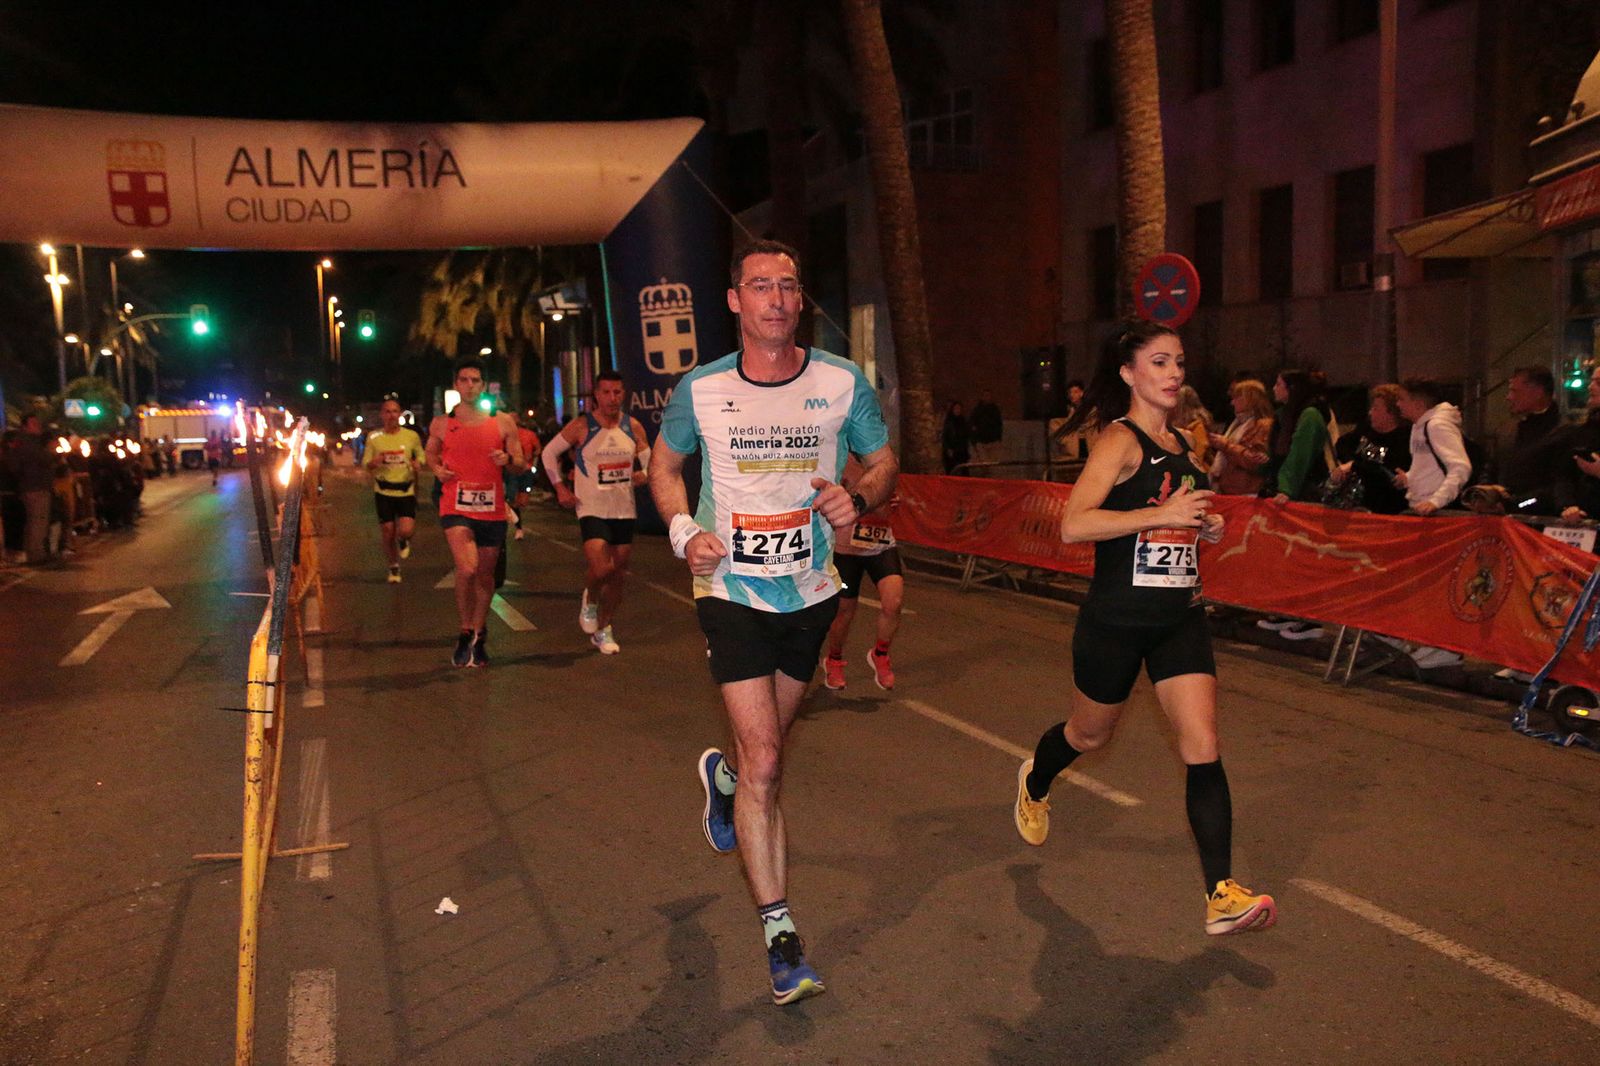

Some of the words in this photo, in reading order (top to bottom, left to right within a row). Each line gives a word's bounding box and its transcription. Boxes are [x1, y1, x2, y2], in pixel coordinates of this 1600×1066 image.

[224, 140, 467, 188] ALMERÍA
[225, 197, 351, 223] CIUDAD
[728, 425, 765, 436] Medio
[771, 424, 821, 436] Maratón
[730, 436, 782, 449] Almería
[785, 435, 819, 449] 2022
[731, 452, 761, 461] RAMÓN
[784, 451, 819, 460] ANDÚJAR
[471, 491, 487, 502] 76
[864, 526, 888, 539] 367
[752, 529, 804, 555] 274
[763, 554, 794, 565] CAYETANO
[1156, 546, 1193, 566] 275
